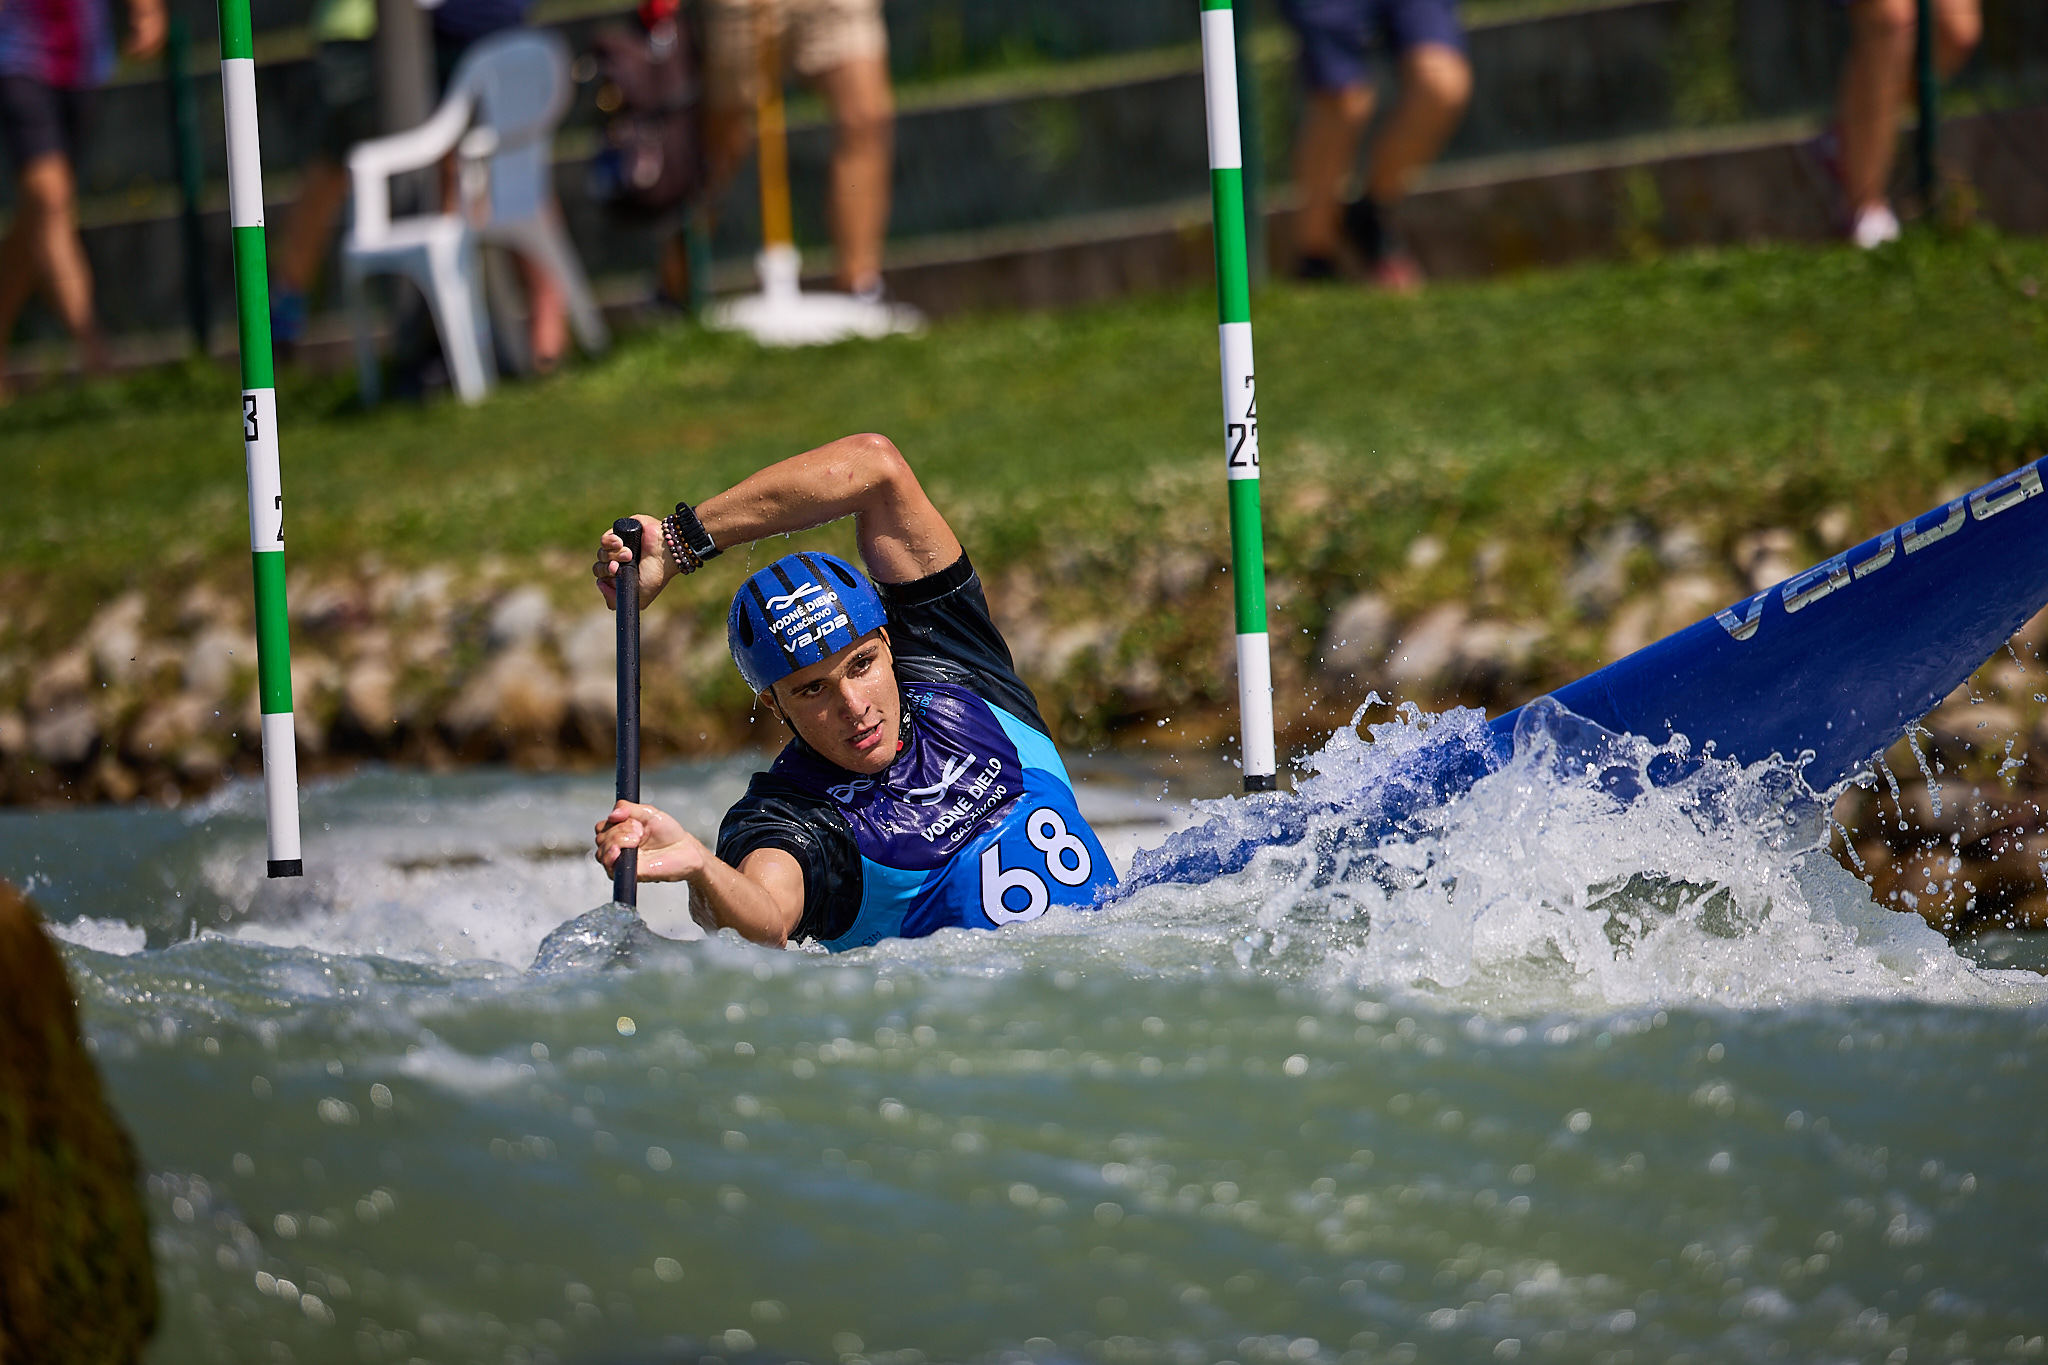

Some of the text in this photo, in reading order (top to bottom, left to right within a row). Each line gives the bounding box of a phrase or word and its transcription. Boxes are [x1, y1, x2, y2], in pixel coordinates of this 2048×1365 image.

[768, 591, 838, 634] VODNÉ DIELO
[786, 607, 832, 636] GABČÍKOVO
[920, 757, 1003, 843] VODNÉ DIELO
[979, 806, 1092, 927] 68
